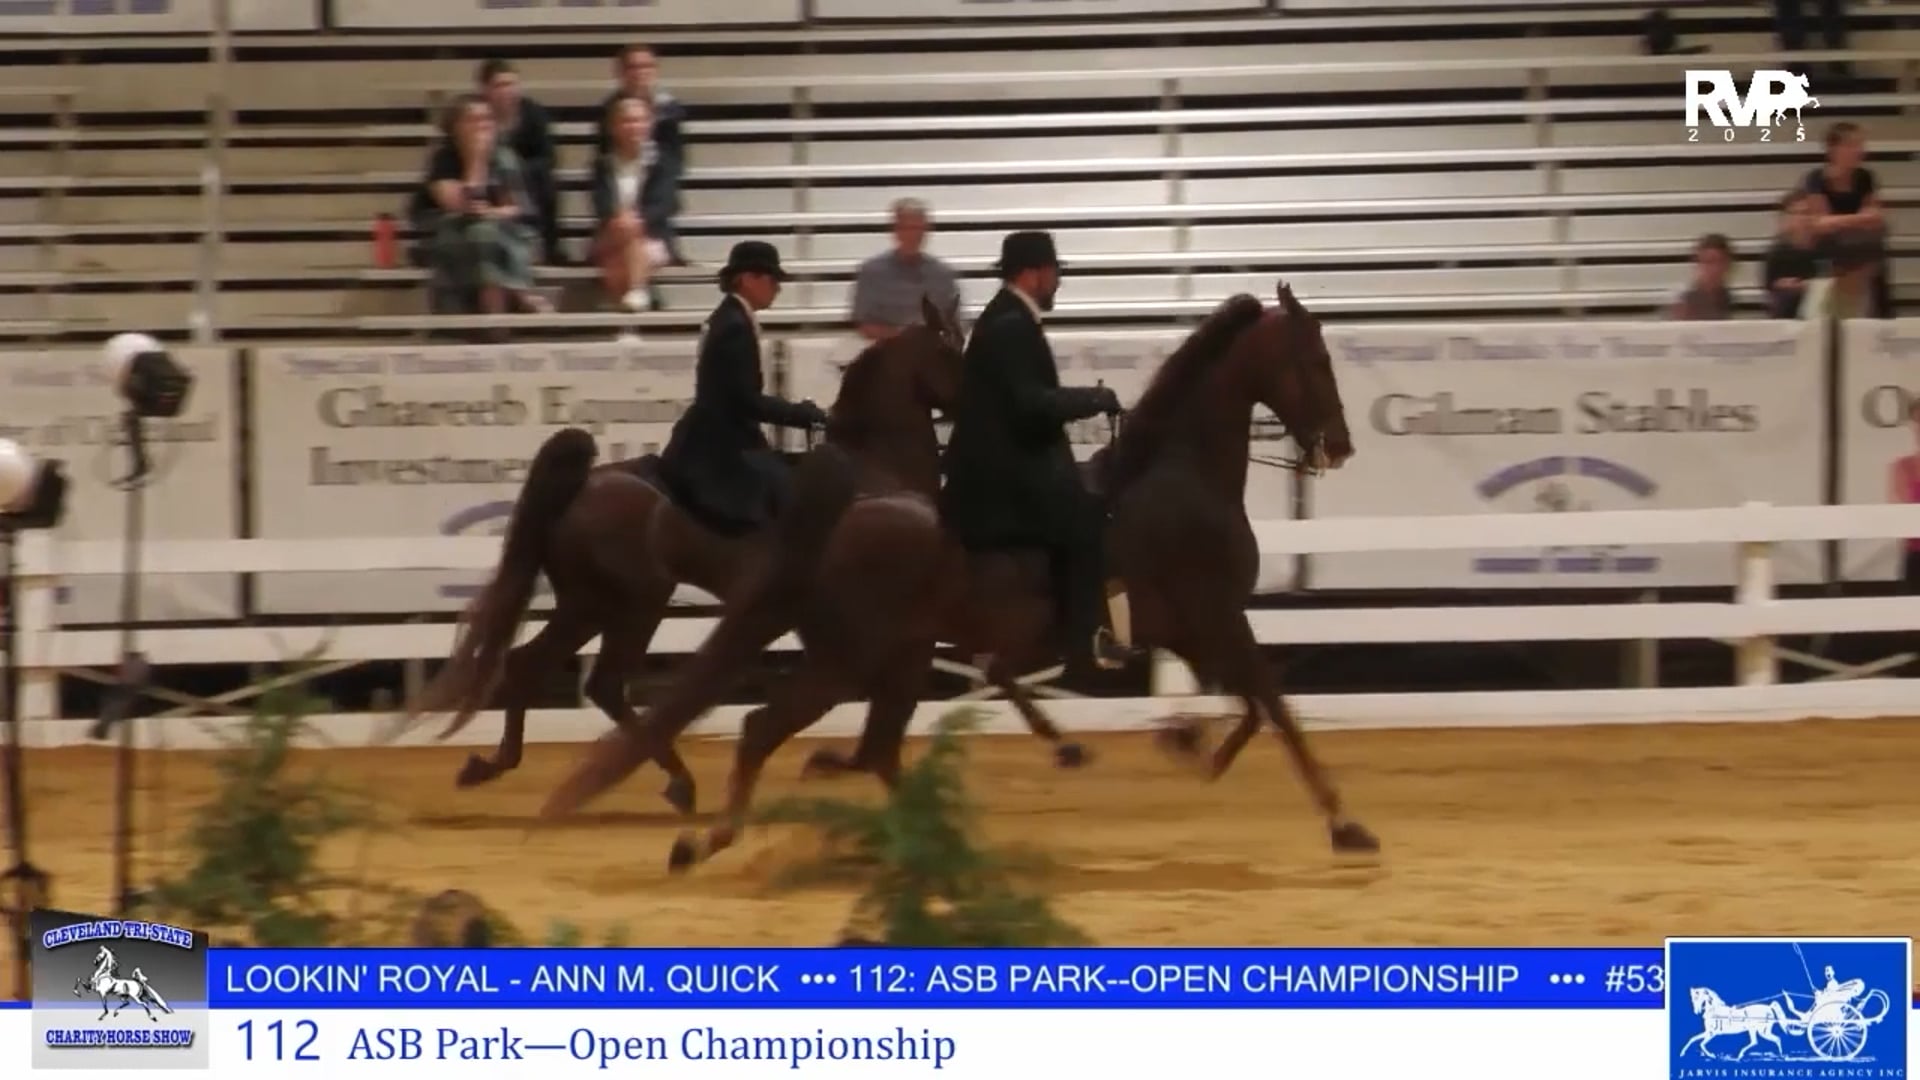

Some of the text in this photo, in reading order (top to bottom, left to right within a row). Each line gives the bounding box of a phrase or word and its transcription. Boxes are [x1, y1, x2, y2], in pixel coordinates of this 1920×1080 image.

[317, 385, 528, 428] Ghareeb
[1369, 388, 1761, 436] Gilman Stables
